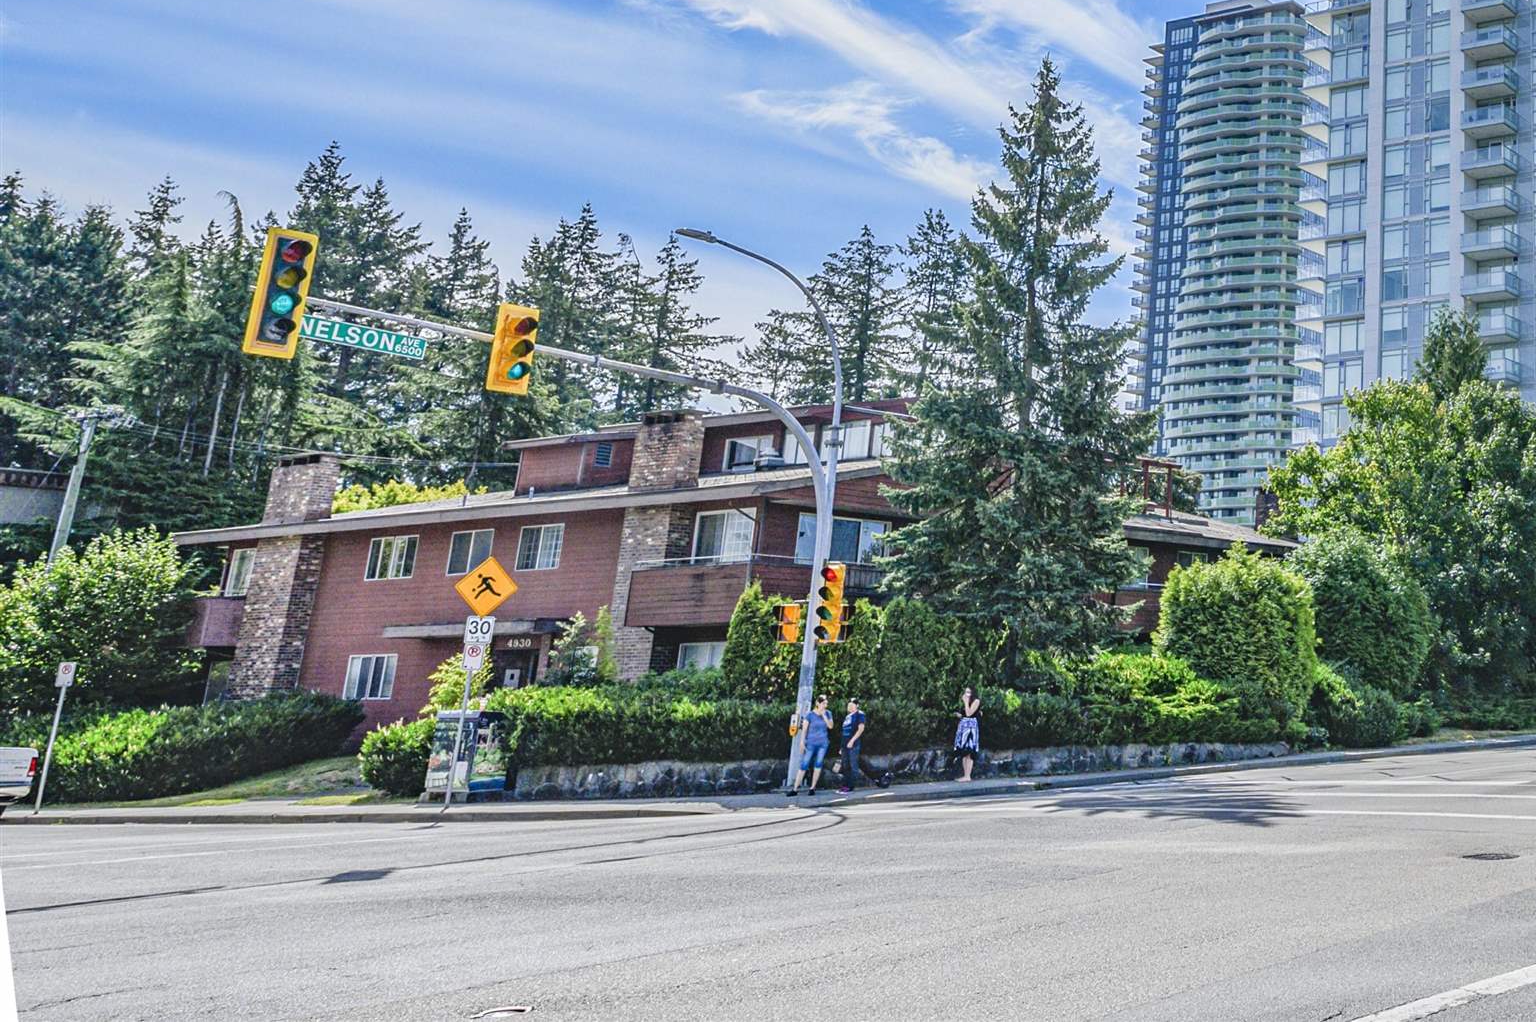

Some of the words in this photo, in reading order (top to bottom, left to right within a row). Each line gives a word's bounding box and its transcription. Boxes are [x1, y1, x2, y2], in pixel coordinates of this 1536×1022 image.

[300, 317, 396, 351] NELSON
[401, 337, 421, 347] AVE
[395, 344, 422, 356] 6500
[469, 620, 491, 635] 30
[507, 638, 532, 648] 4930
